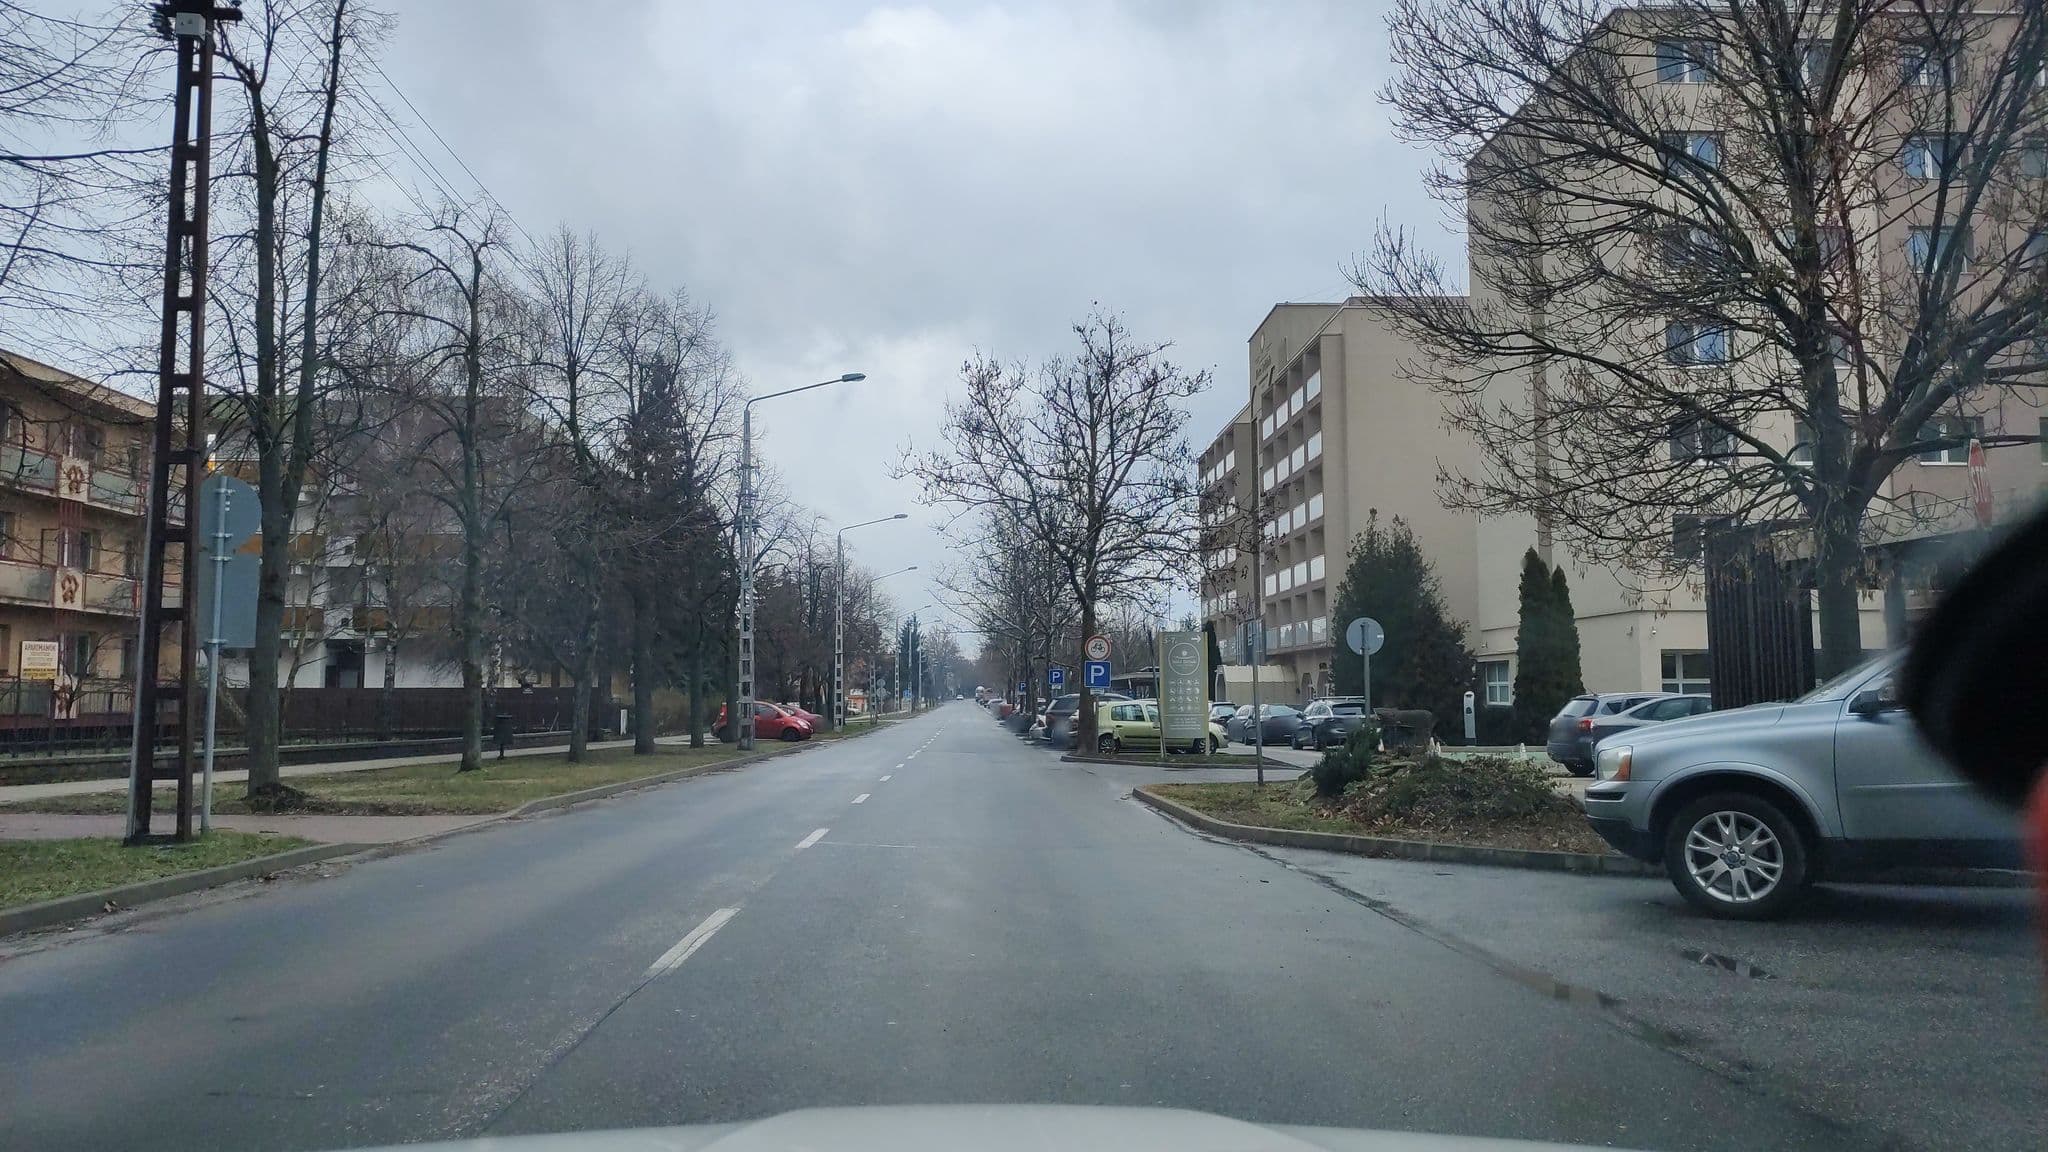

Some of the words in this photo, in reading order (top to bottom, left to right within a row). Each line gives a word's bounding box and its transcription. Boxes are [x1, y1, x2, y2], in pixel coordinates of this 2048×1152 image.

[1971, 465, 1989, 503] STOP
[1052, 671, 1061, 682] P
[1090, 665, 1105, 684] P
